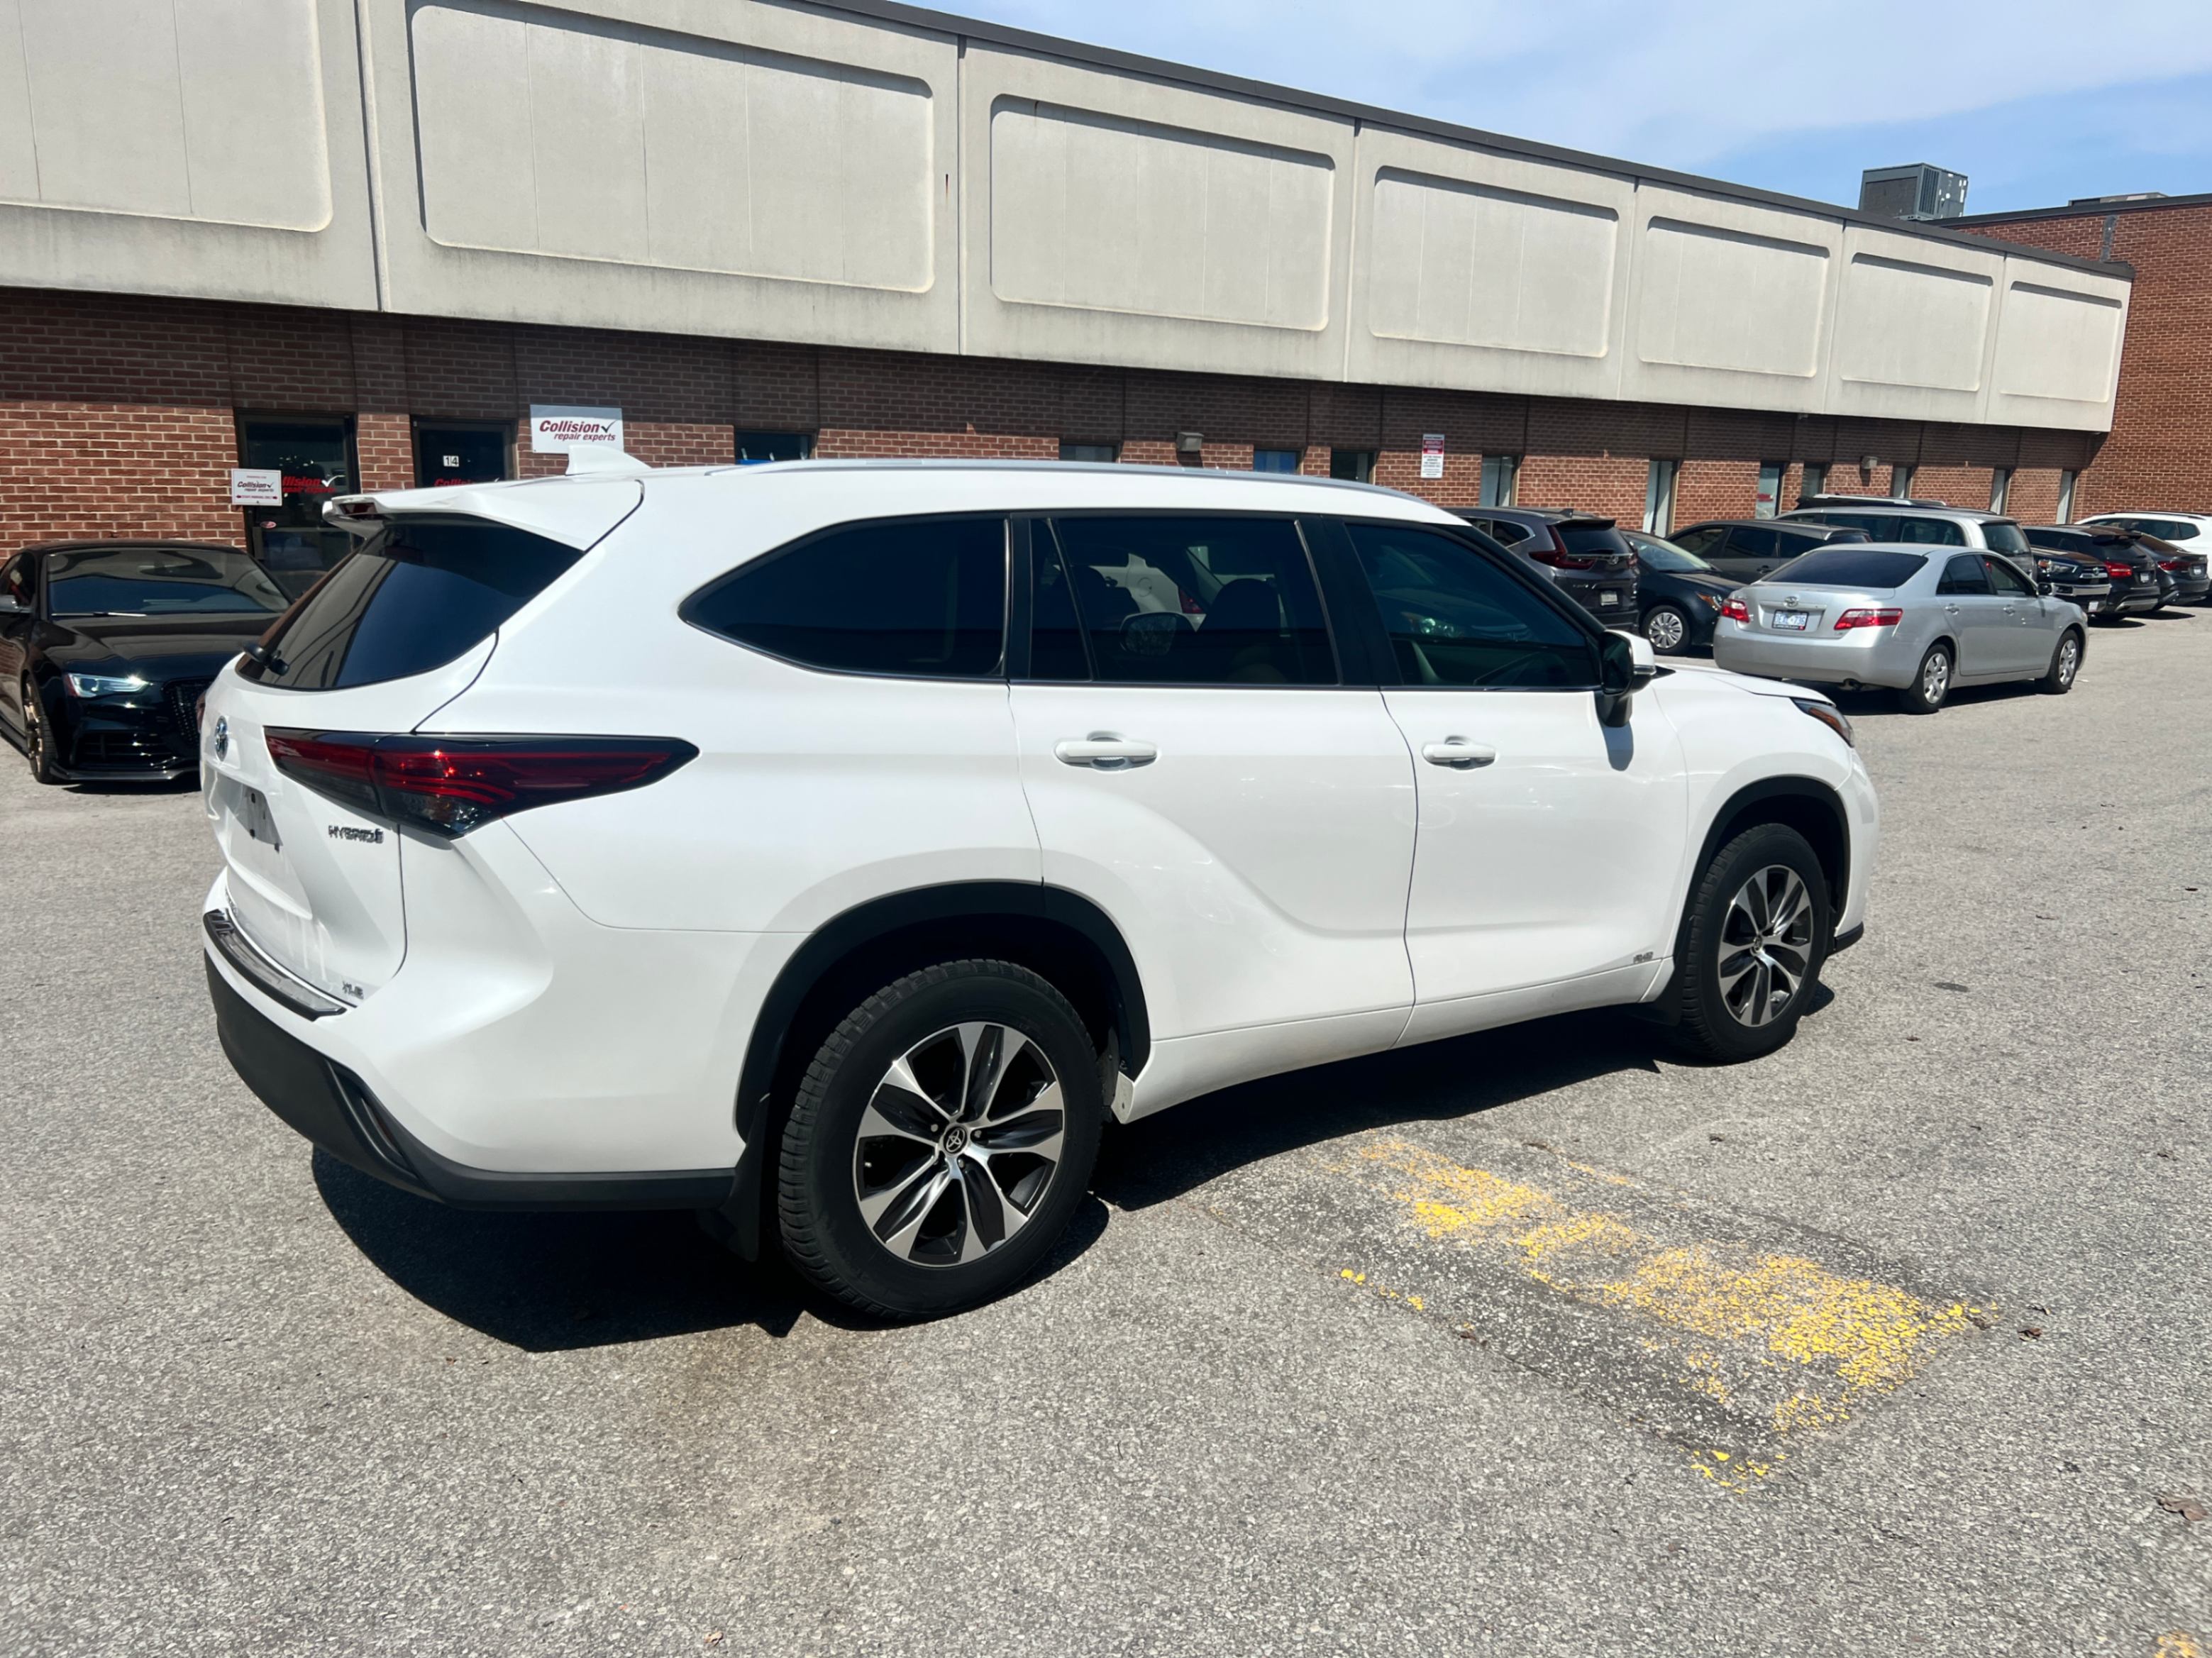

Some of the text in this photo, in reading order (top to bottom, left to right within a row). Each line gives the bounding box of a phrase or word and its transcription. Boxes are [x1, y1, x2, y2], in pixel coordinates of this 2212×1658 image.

[539, 420, 600, 433] Collision
[553, 432, 616, 442] repair experts
[445, 456, 459, 465] 14
[283, 476, 321, 486] llision
[328, 825, 375, 844] HYBRID
[342, 980, 364, 1000] XLE
